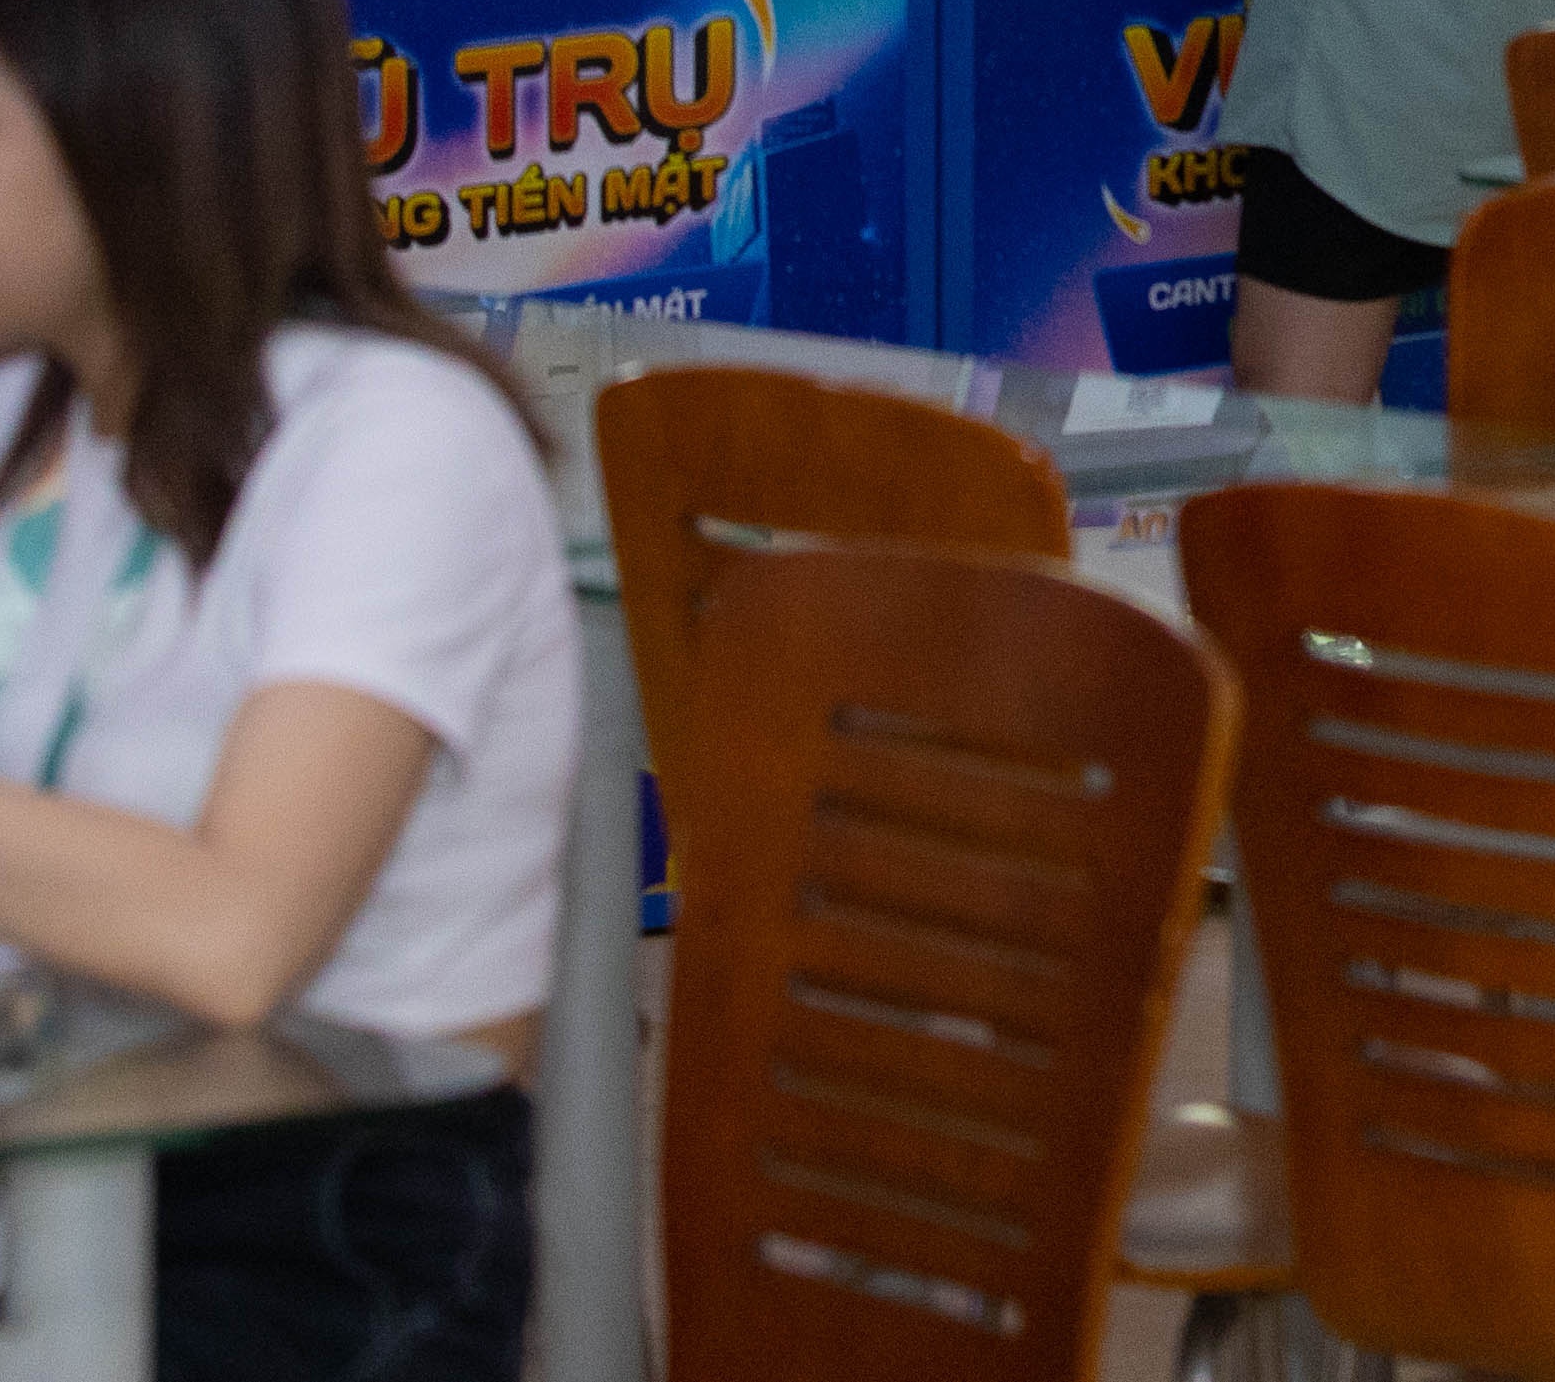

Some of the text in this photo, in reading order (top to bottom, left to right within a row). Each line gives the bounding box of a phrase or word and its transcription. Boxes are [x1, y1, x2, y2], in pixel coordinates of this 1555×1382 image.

[454, 17, 736, 155] TRỤ
[602, 150, 728, 226] MẶT
[1148, 273, 1236, 310] CANT
